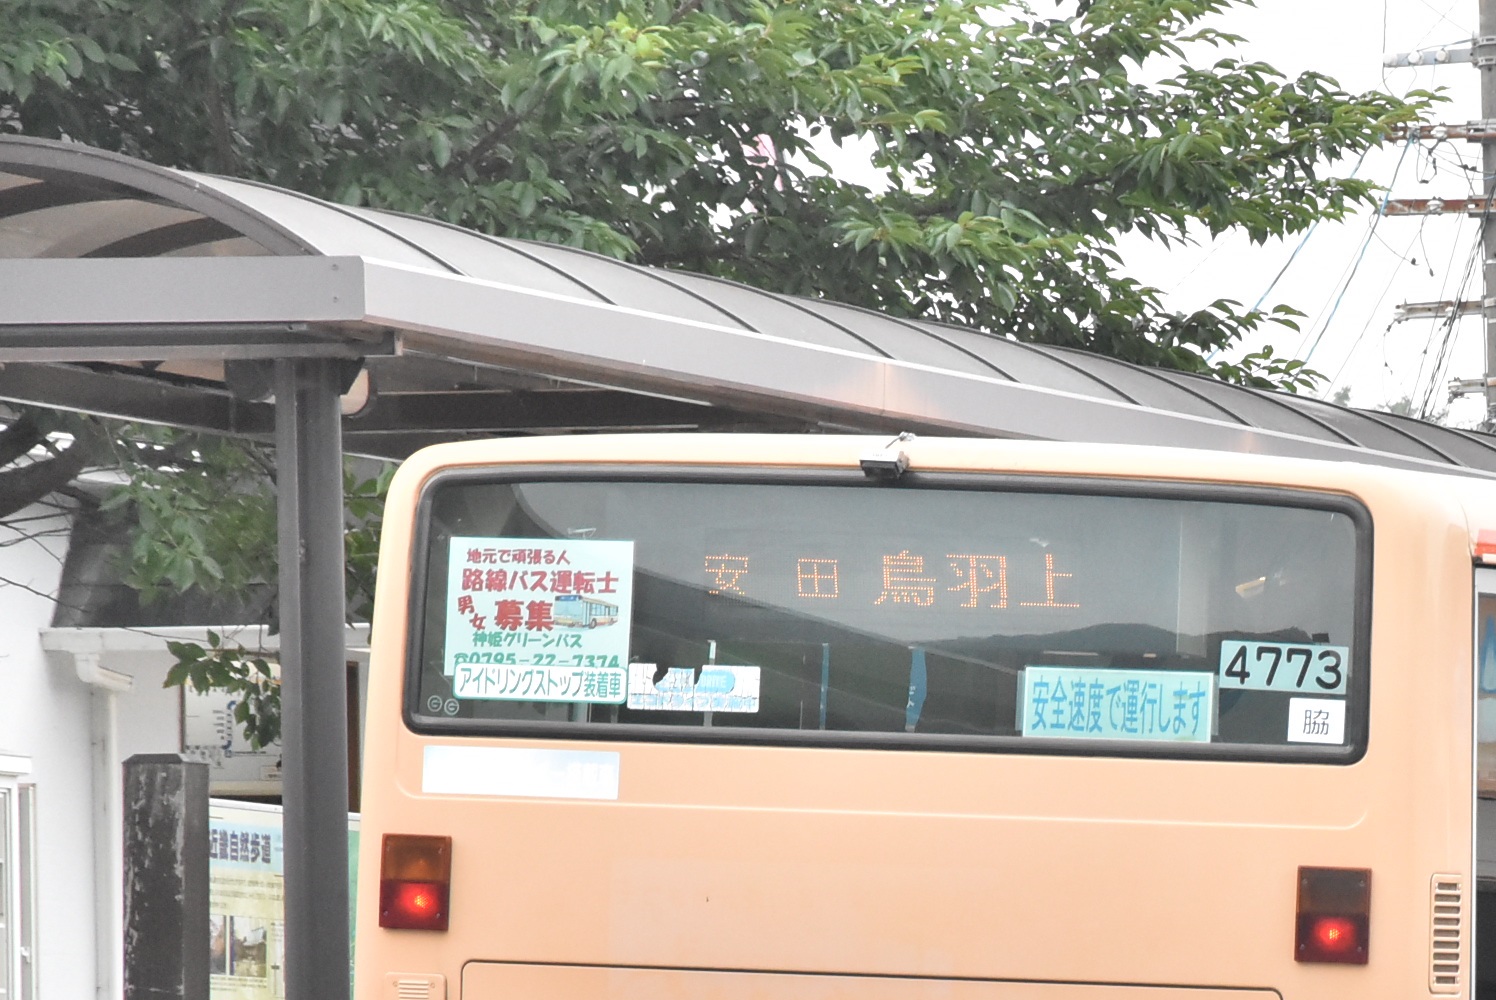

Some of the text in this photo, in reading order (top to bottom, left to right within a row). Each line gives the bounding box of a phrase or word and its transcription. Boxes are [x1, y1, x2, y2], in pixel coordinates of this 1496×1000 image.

[466, 548, 571, 566] 地元で頑張る人
[461, 568, 620, 595] 路線バス運転士
[704, 550, 1081, 609] 安田 鳥羽上
[494, 599, 555, 632] 募集
[472, 631, 583, 649] 神姫グリーンバス
[459, 667, 622, 699] アイドリングストップ装着車
[1224, 644, 1343, 691] 4773
[1030, 674, 1207, 735] 安全速度で運行します
[1302, 708, 1330, 736] 脇
